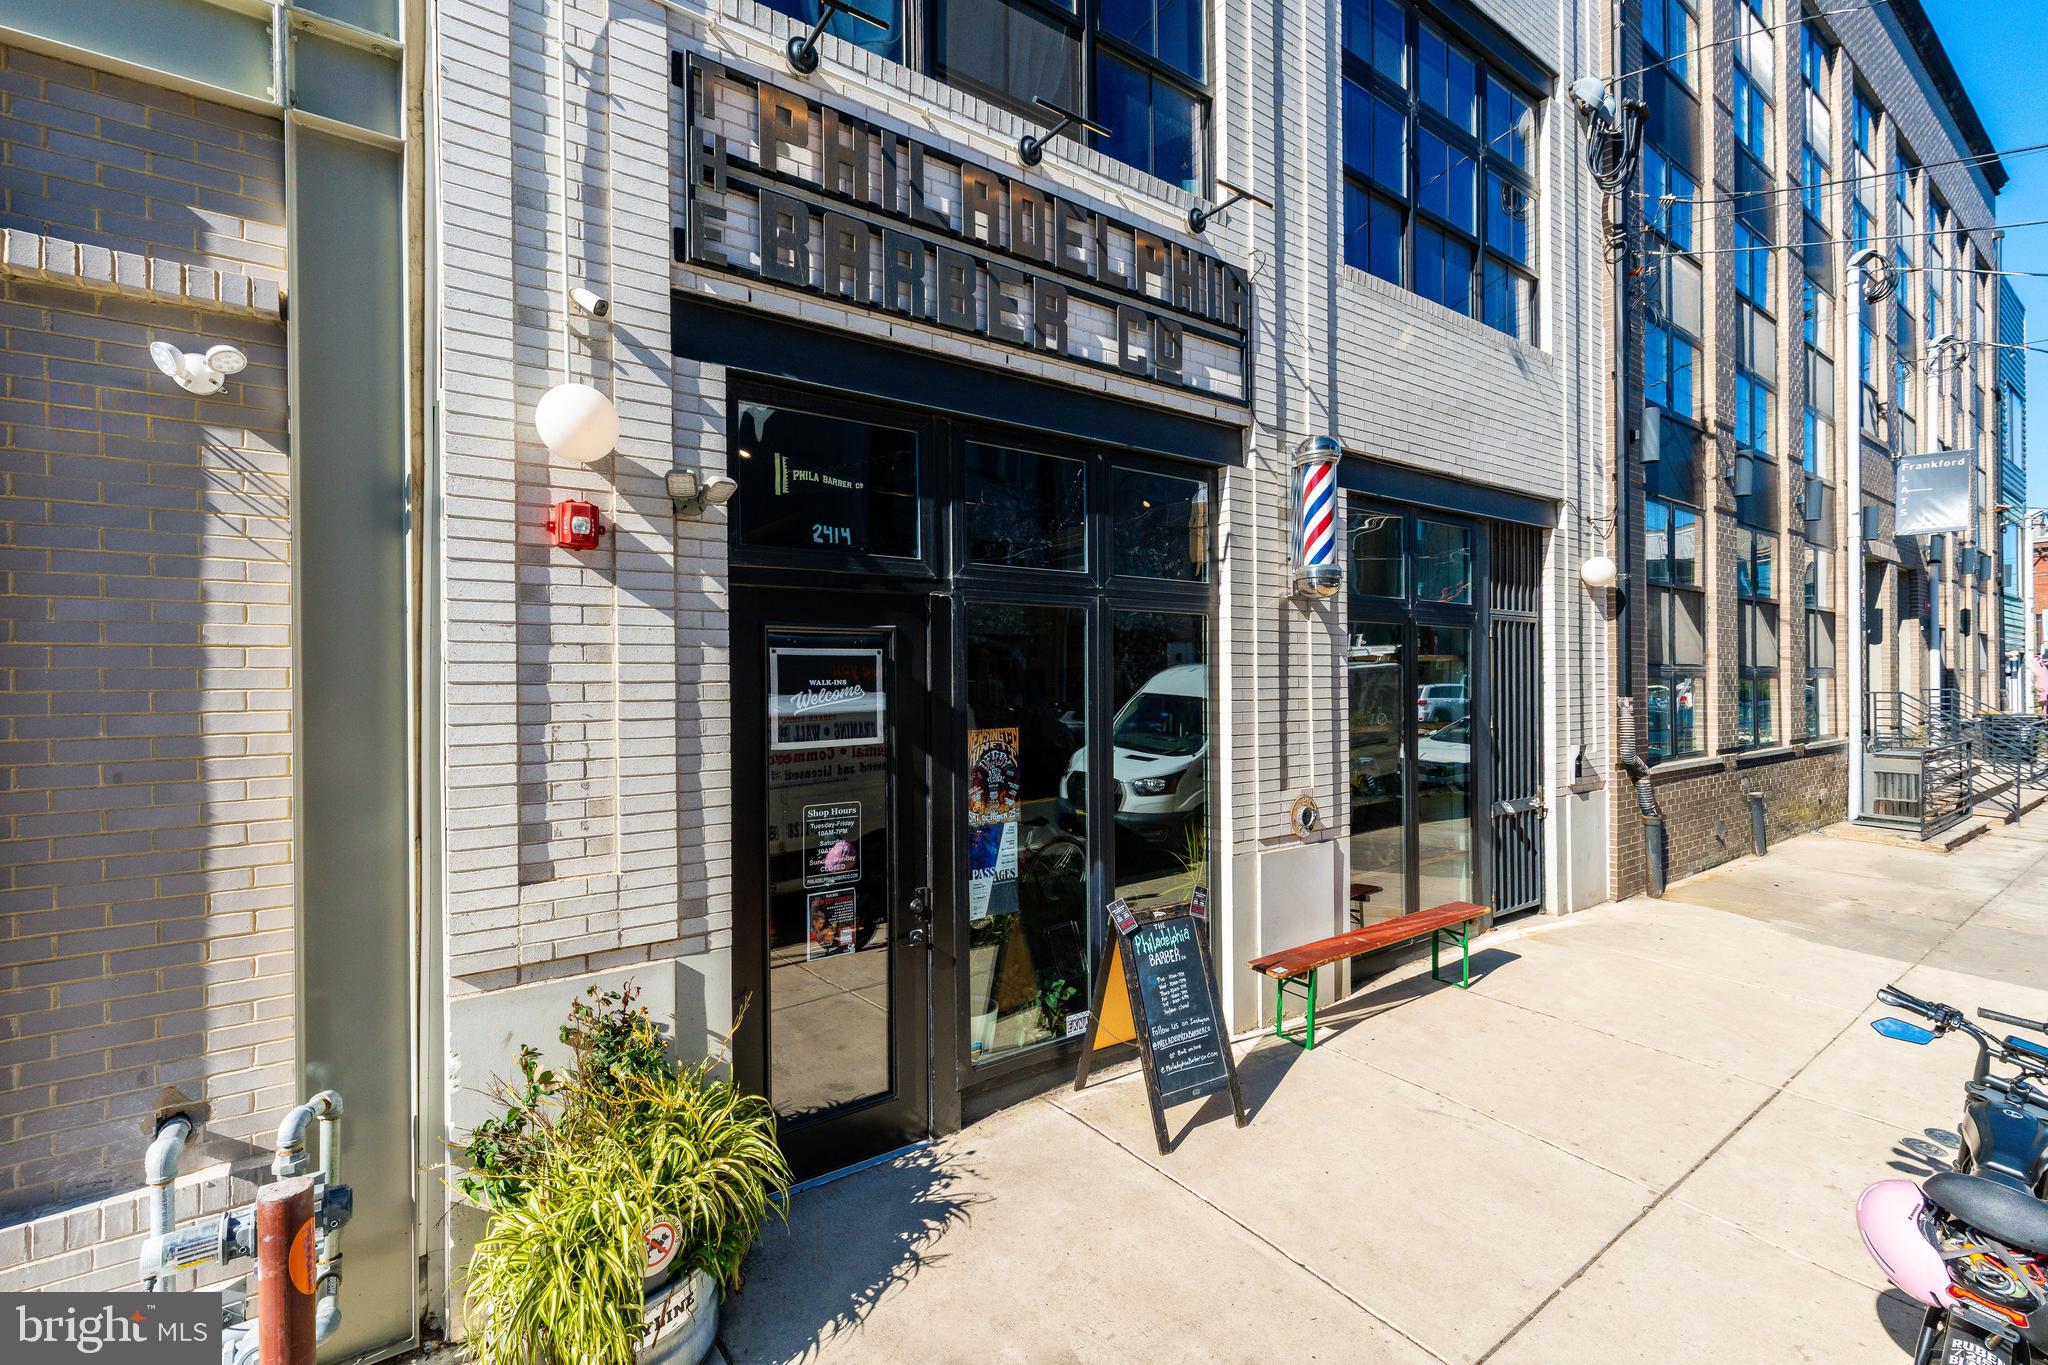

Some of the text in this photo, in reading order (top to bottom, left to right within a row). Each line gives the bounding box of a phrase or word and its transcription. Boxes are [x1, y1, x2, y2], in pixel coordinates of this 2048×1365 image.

[757, 81, 1249, 331] PHILADELPHIA
[759, 188, 1185, 388] BARBER CO
[1902, 457, 1966, 471] Frankford
[792, 469, 820, 482] PHILA
[822, 474, 853, 489] BARBER
[812, 523, 852, 545] 2414
[790, 684, 866, 714] Welcome
[807, 807, 857, 818] Shop Hours
[810, 820, 855, 829] Tuesday-Friday
[972, 867, 1016, 881] PASSAGES
[1153, 922, 1166, 930] THE
[1134, 926, 1190, 956] Philadelphia
[1148, 948, 1181, 967] BARBER
[1151, 1025, 1170, 1037] Follow
